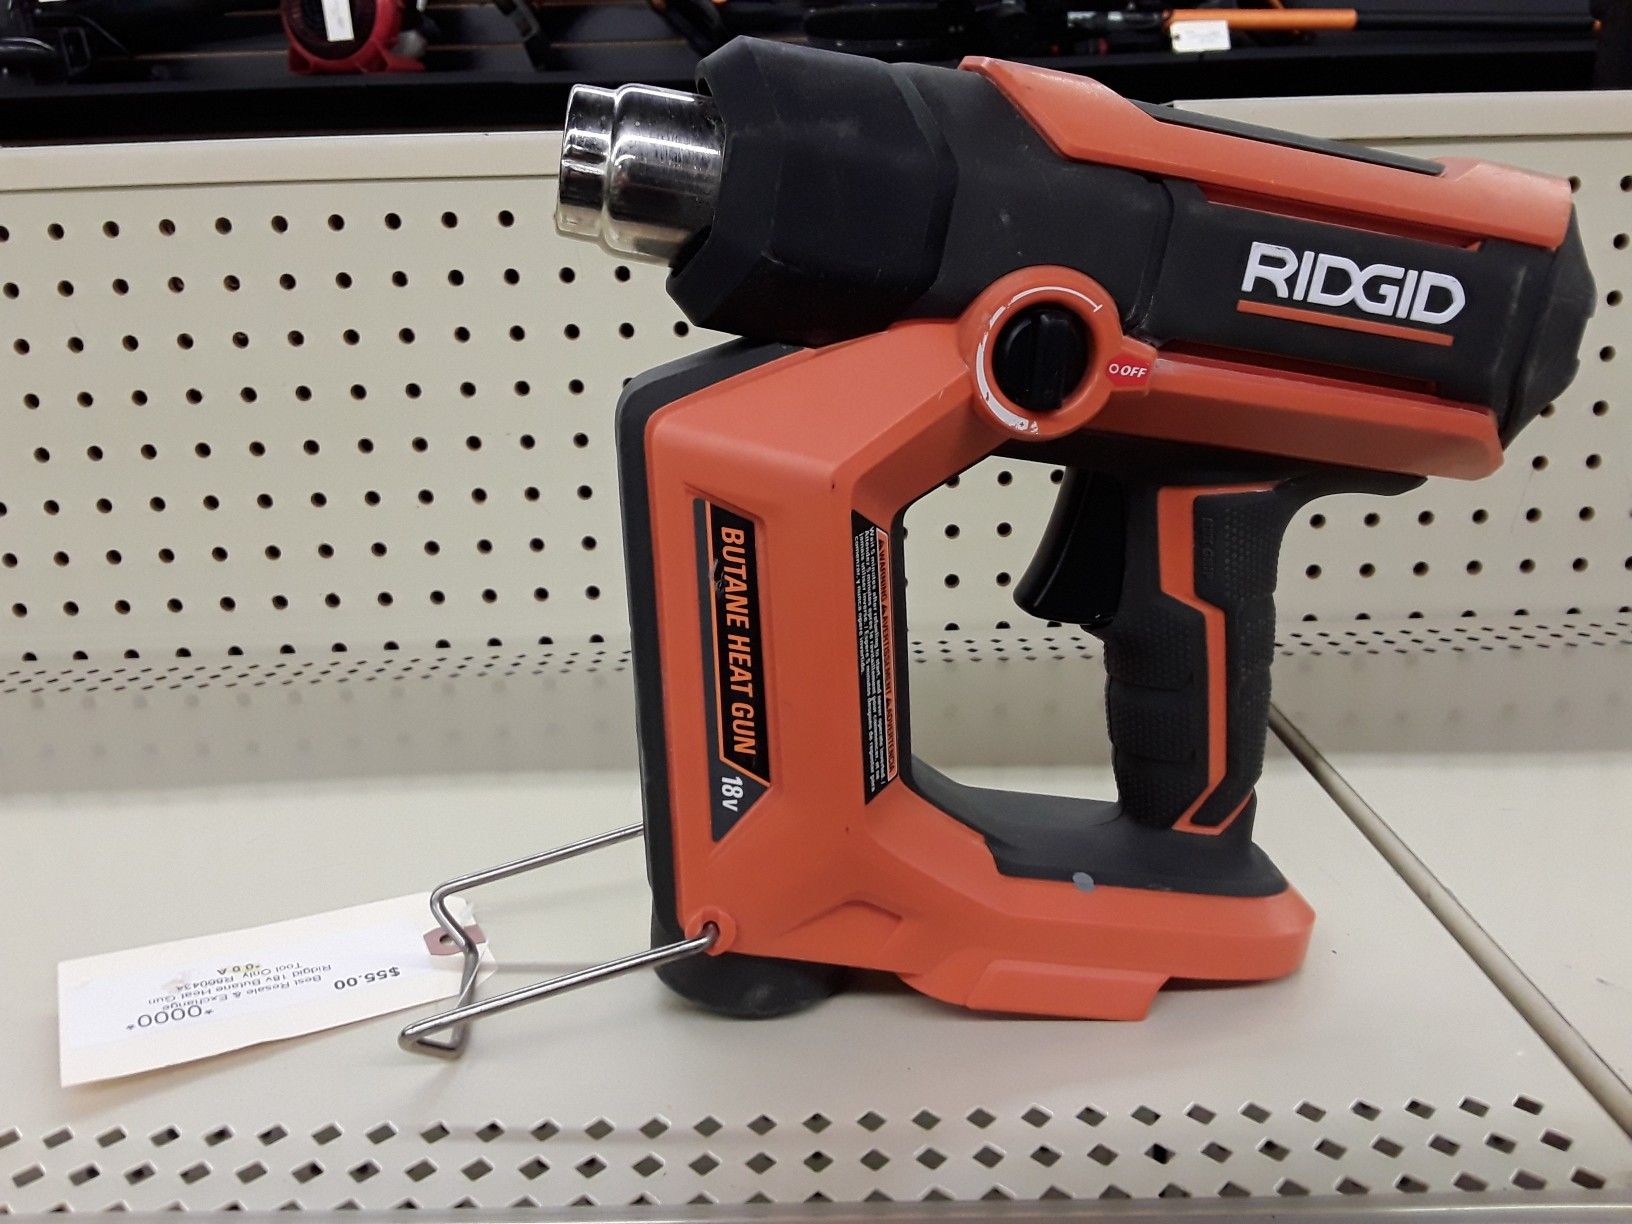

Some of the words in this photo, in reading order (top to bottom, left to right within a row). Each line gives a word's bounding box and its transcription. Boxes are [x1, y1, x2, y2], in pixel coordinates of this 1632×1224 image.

[1240, 241, 1467, 325] RIDGID
[720, 526, 750, 630] BUTANE
[726, 634, 753, 698] HEAT
[731, 702, 757, 756] GUN
[334, 966, 401, 990] $55.00
